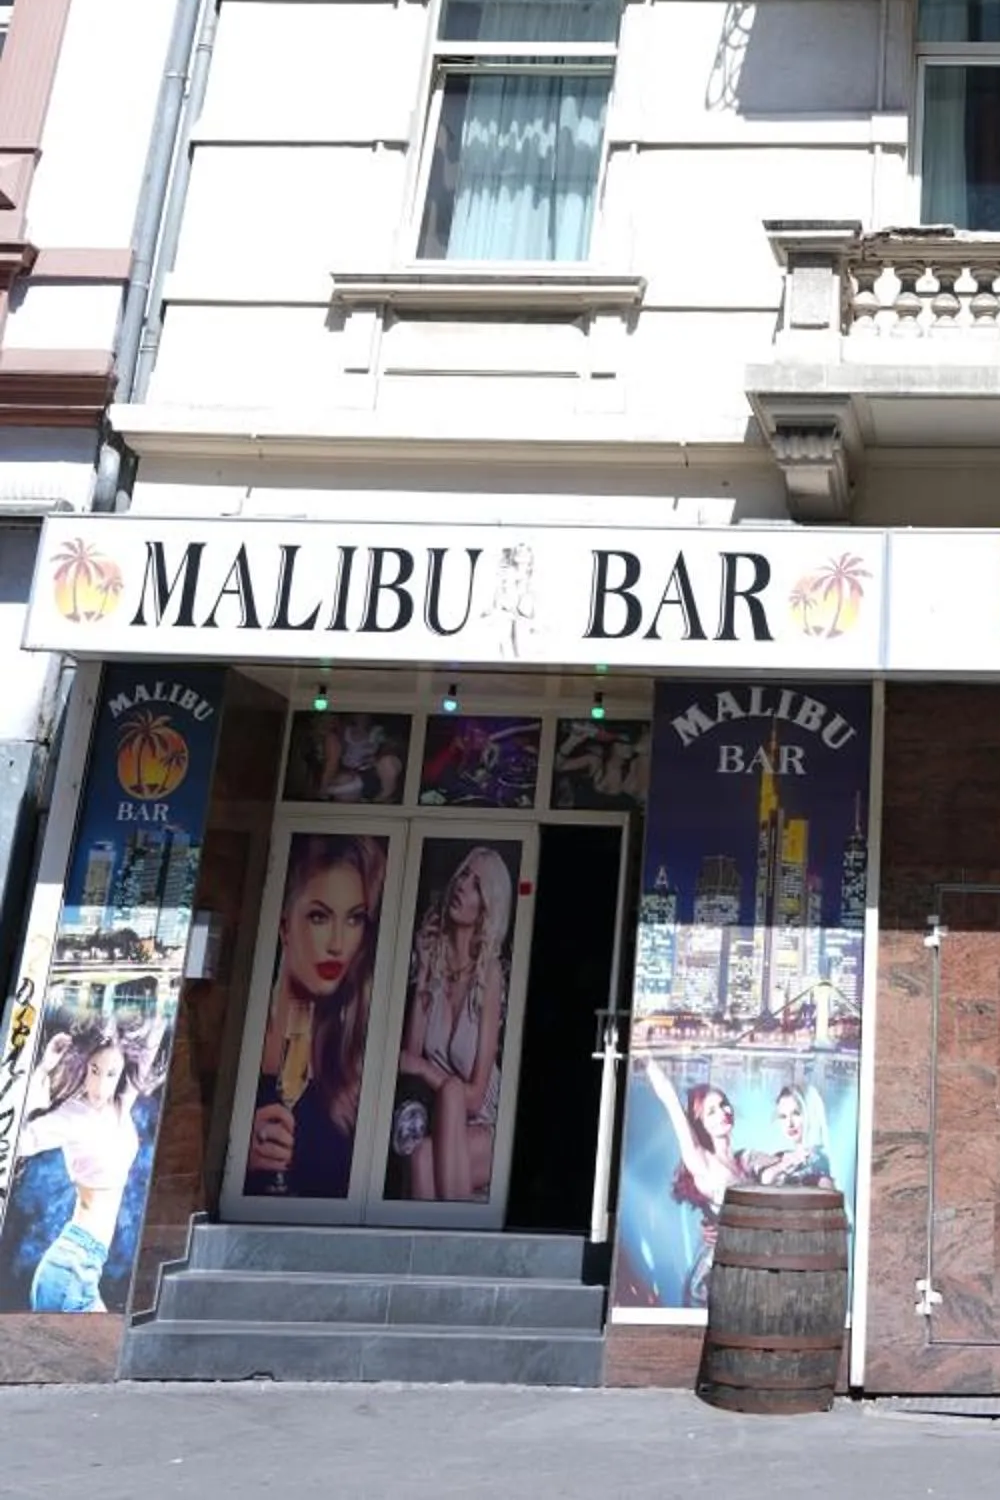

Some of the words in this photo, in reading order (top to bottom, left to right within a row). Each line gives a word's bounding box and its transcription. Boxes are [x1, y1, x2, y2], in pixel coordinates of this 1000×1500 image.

[130, 541, 483, 636] MALIBU
[582, 549, 776, 641] BAR
[109, 681, 215, 722] MALIBU
[669, 686, 857, 750] MALIBU
[717, 745, 807, 775] BAR
[116, 802, 169, 821] BAR
